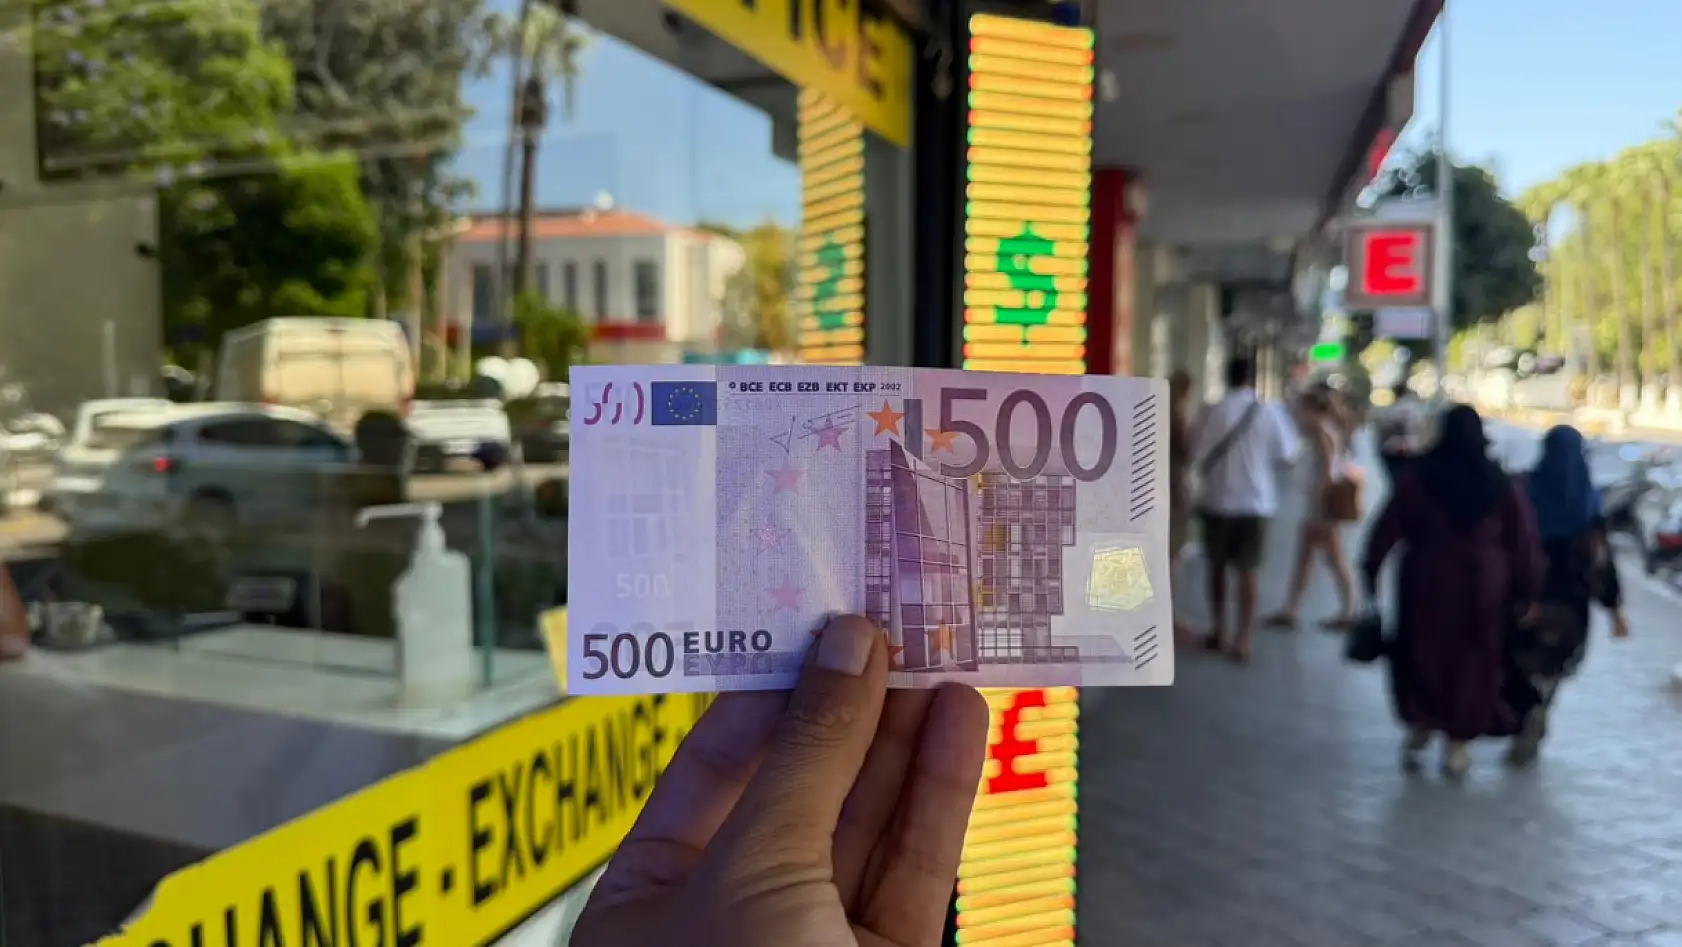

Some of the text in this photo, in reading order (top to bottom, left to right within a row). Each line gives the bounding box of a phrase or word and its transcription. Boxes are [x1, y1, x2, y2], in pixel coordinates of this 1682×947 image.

[993, 220, 1058, 347] $
[1363, 231, 1424, 296] E
[739, 381, 764, 393] BCE
[768, 381, 793, 393] ECB
[796, 381, 821, 393] EZB
[825, 381, 849, 393] EKT
[853, 381, 877, 393] EKP
[939, 386, 1118, 482] 500
[582, 629, 773, 680] 500 EURO
[469, 691, 669, 909] EXCHANGE
